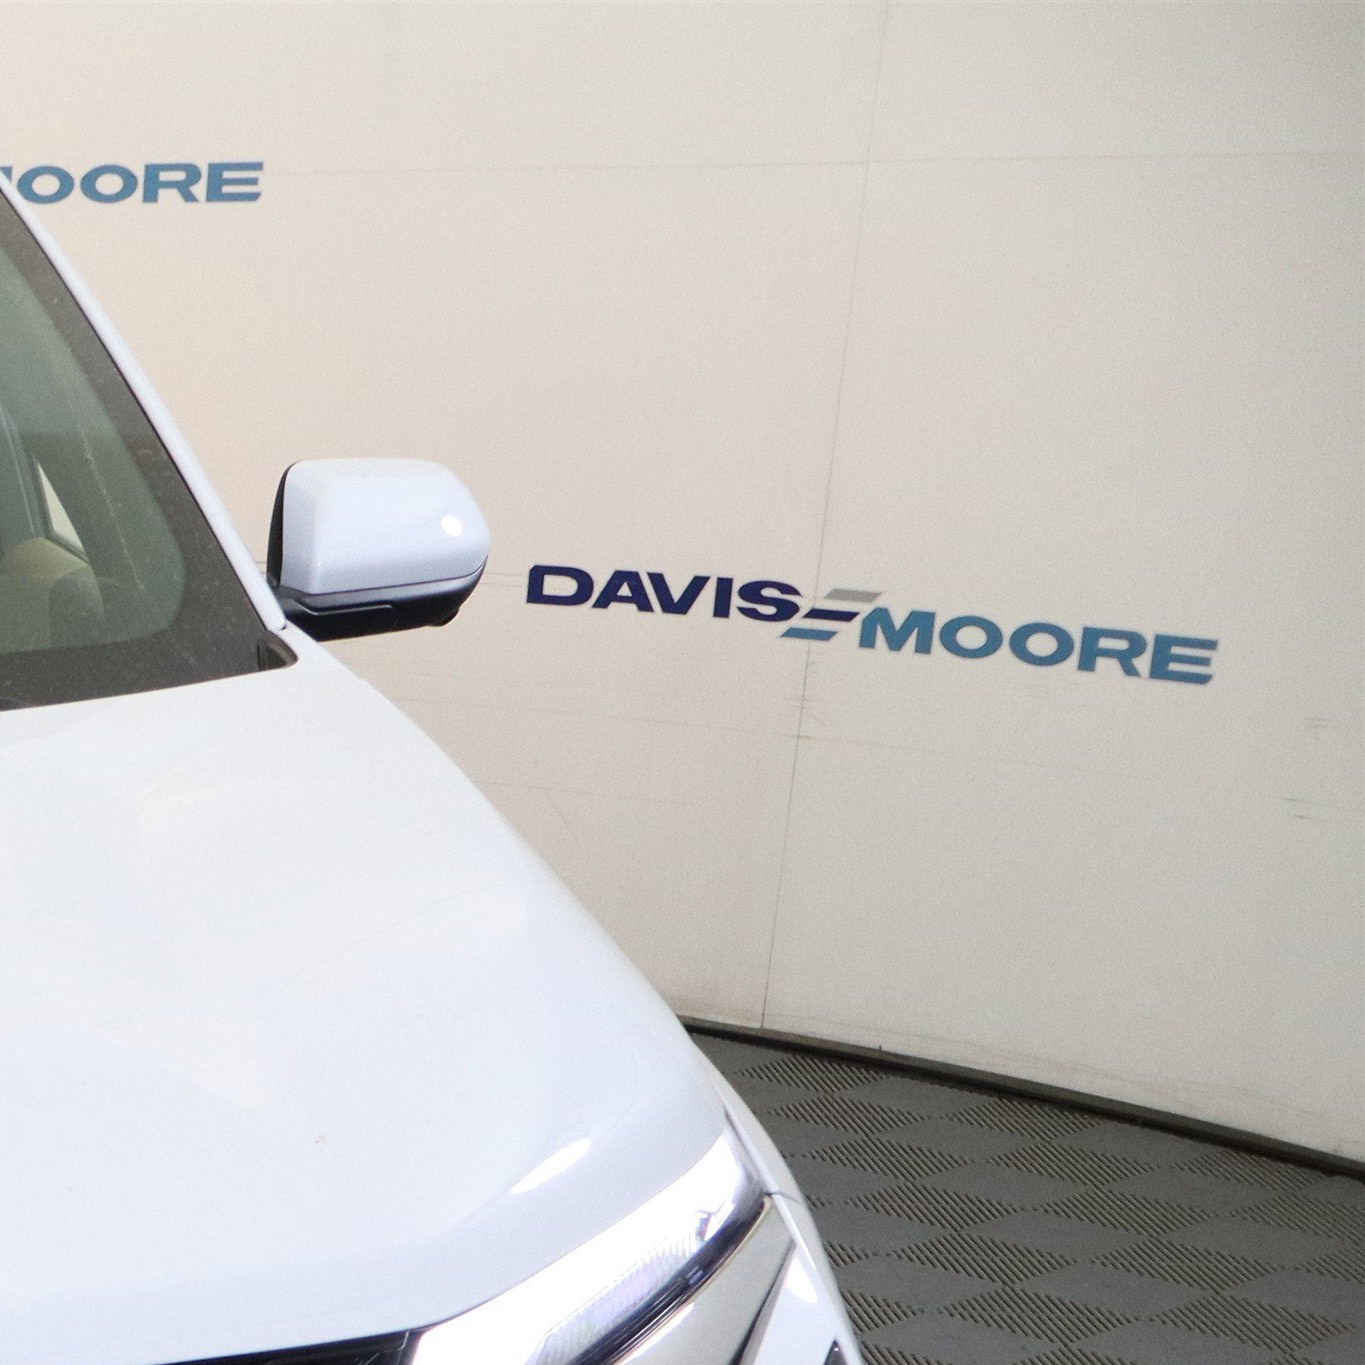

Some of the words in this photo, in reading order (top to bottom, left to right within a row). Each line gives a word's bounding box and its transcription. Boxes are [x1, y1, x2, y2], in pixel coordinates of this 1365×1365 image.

[2, 161, 264, 204] OORE
[526, 564, 802, 623] DAVIS
[858, 606, 1219, 685] MOORE
